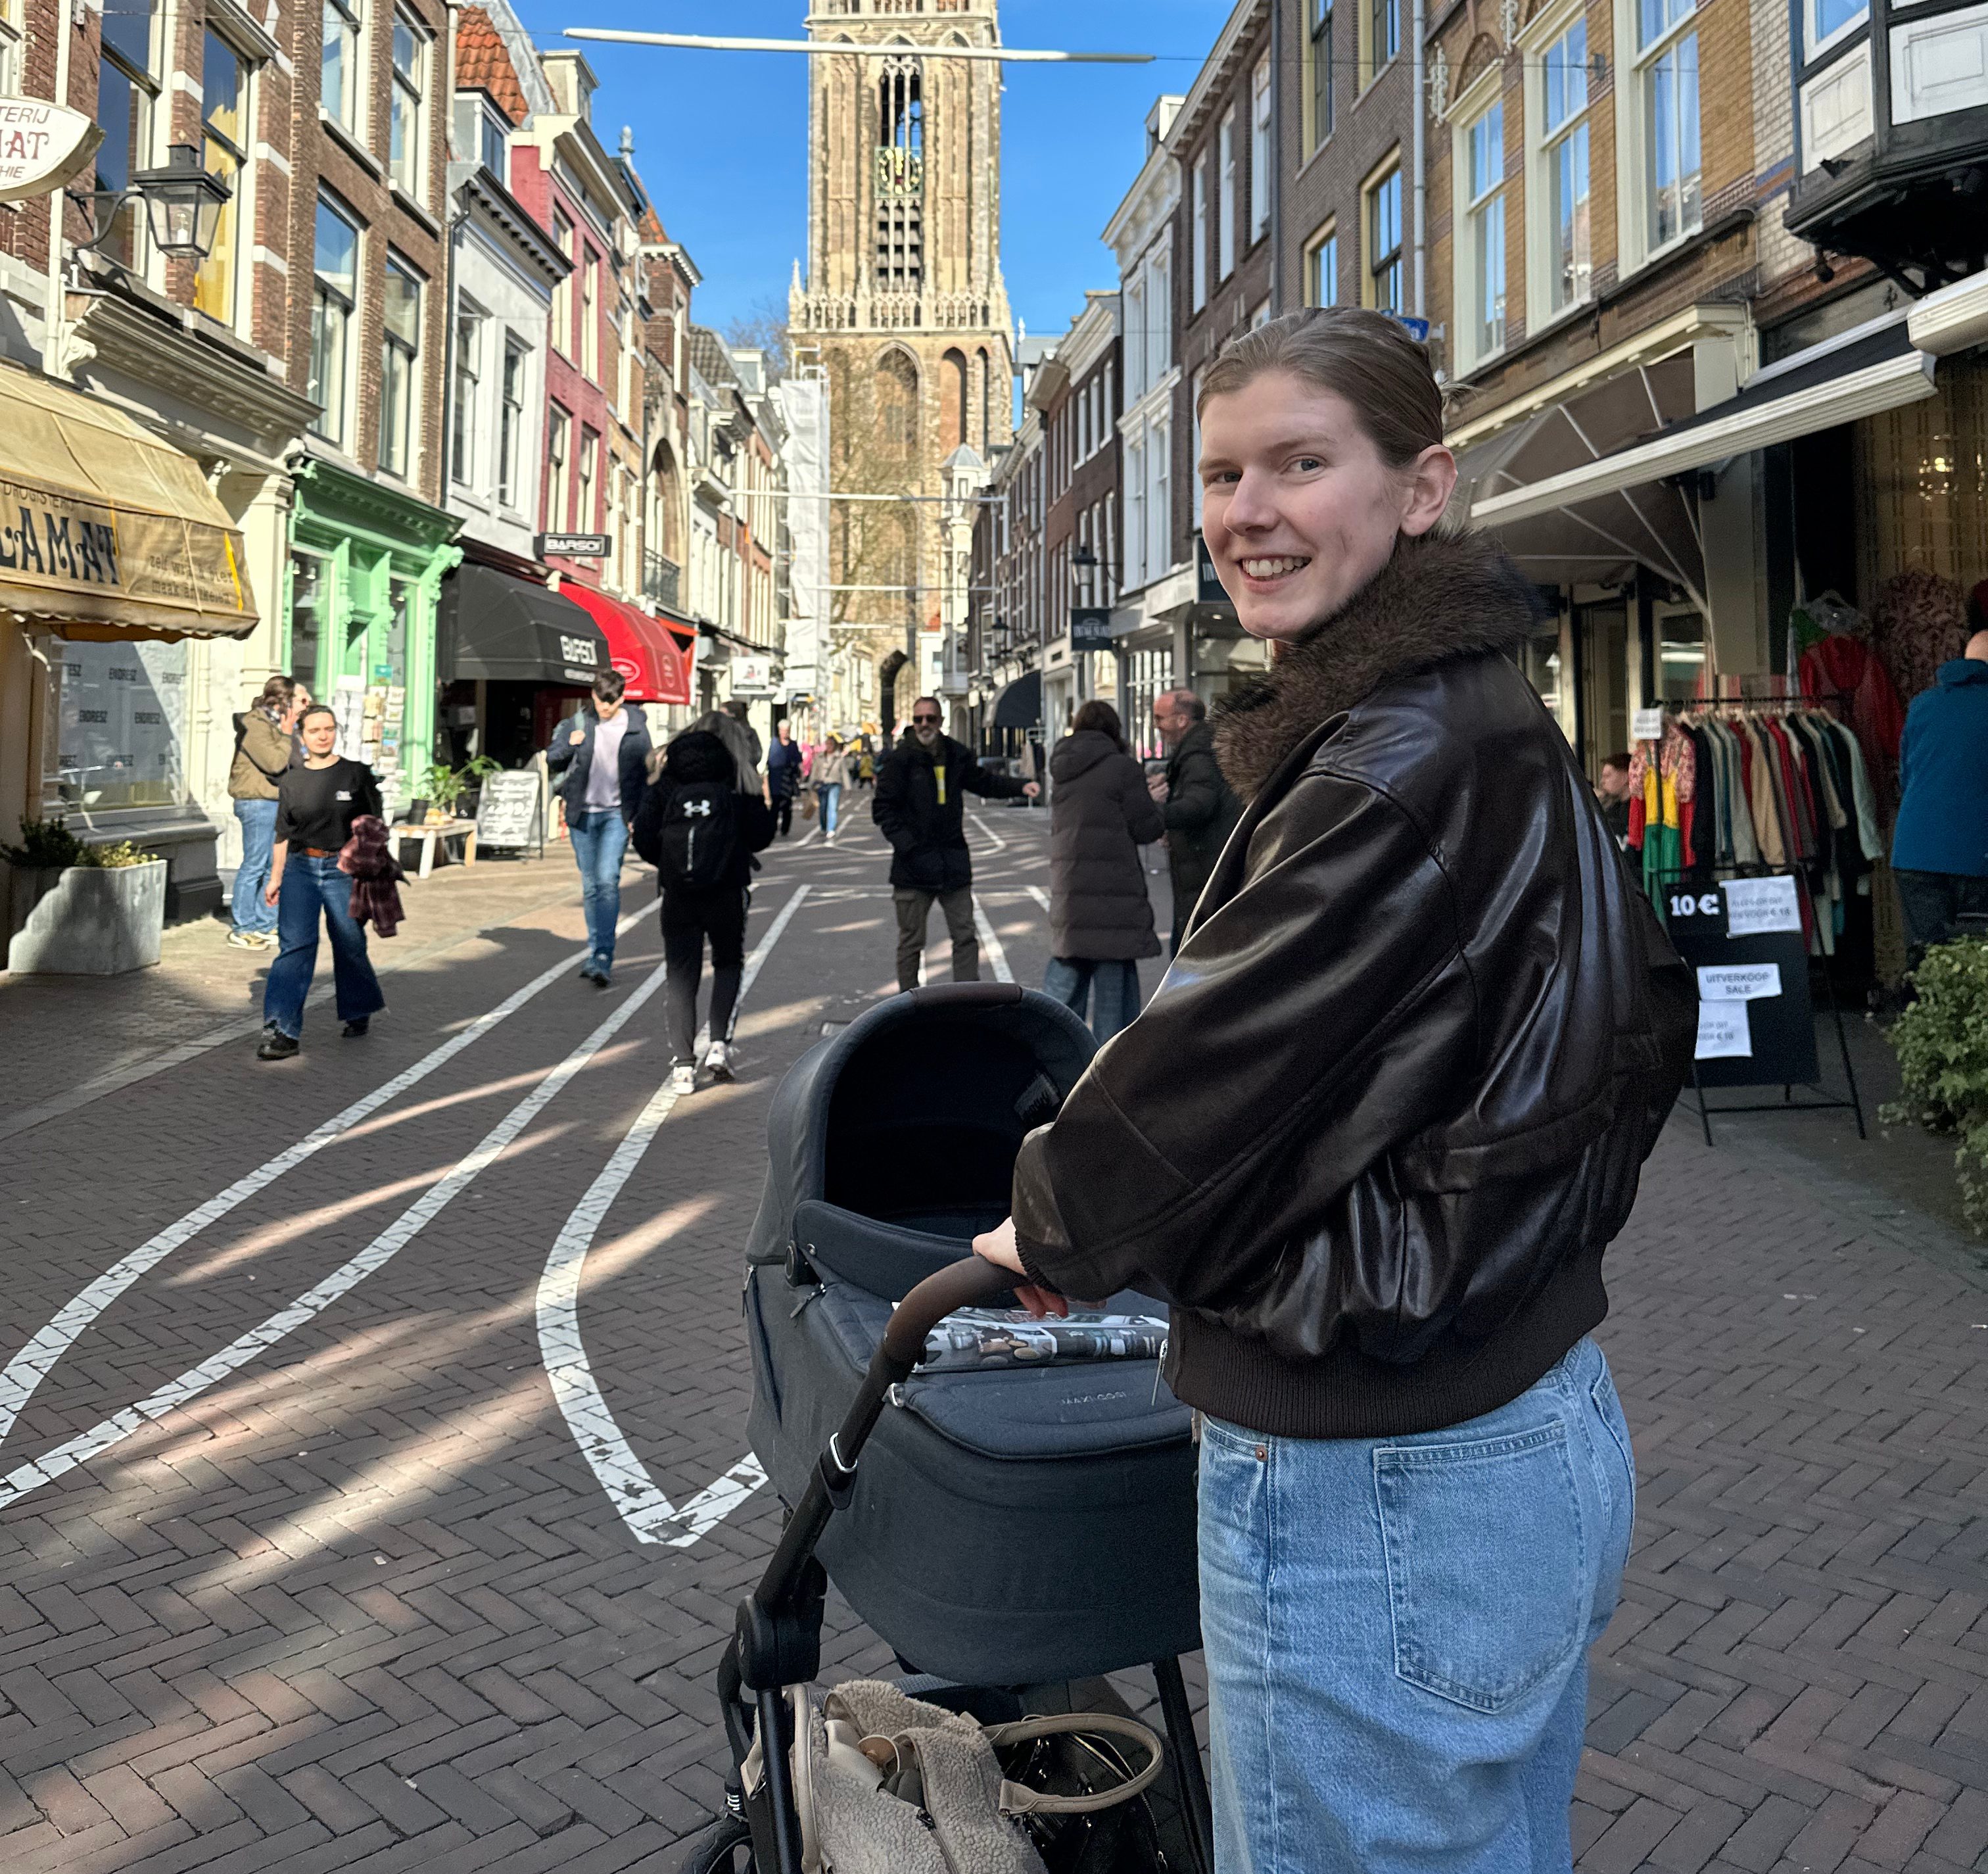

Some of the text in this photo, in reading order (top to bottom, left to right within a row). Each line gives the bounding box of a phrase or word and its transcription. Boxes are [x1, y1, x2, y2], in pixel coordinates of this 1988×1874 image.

[0, 130, 49, 160] AT
[1669, 894, 1696, 917] 10
[1726, 985, 1752, 995] SALE
